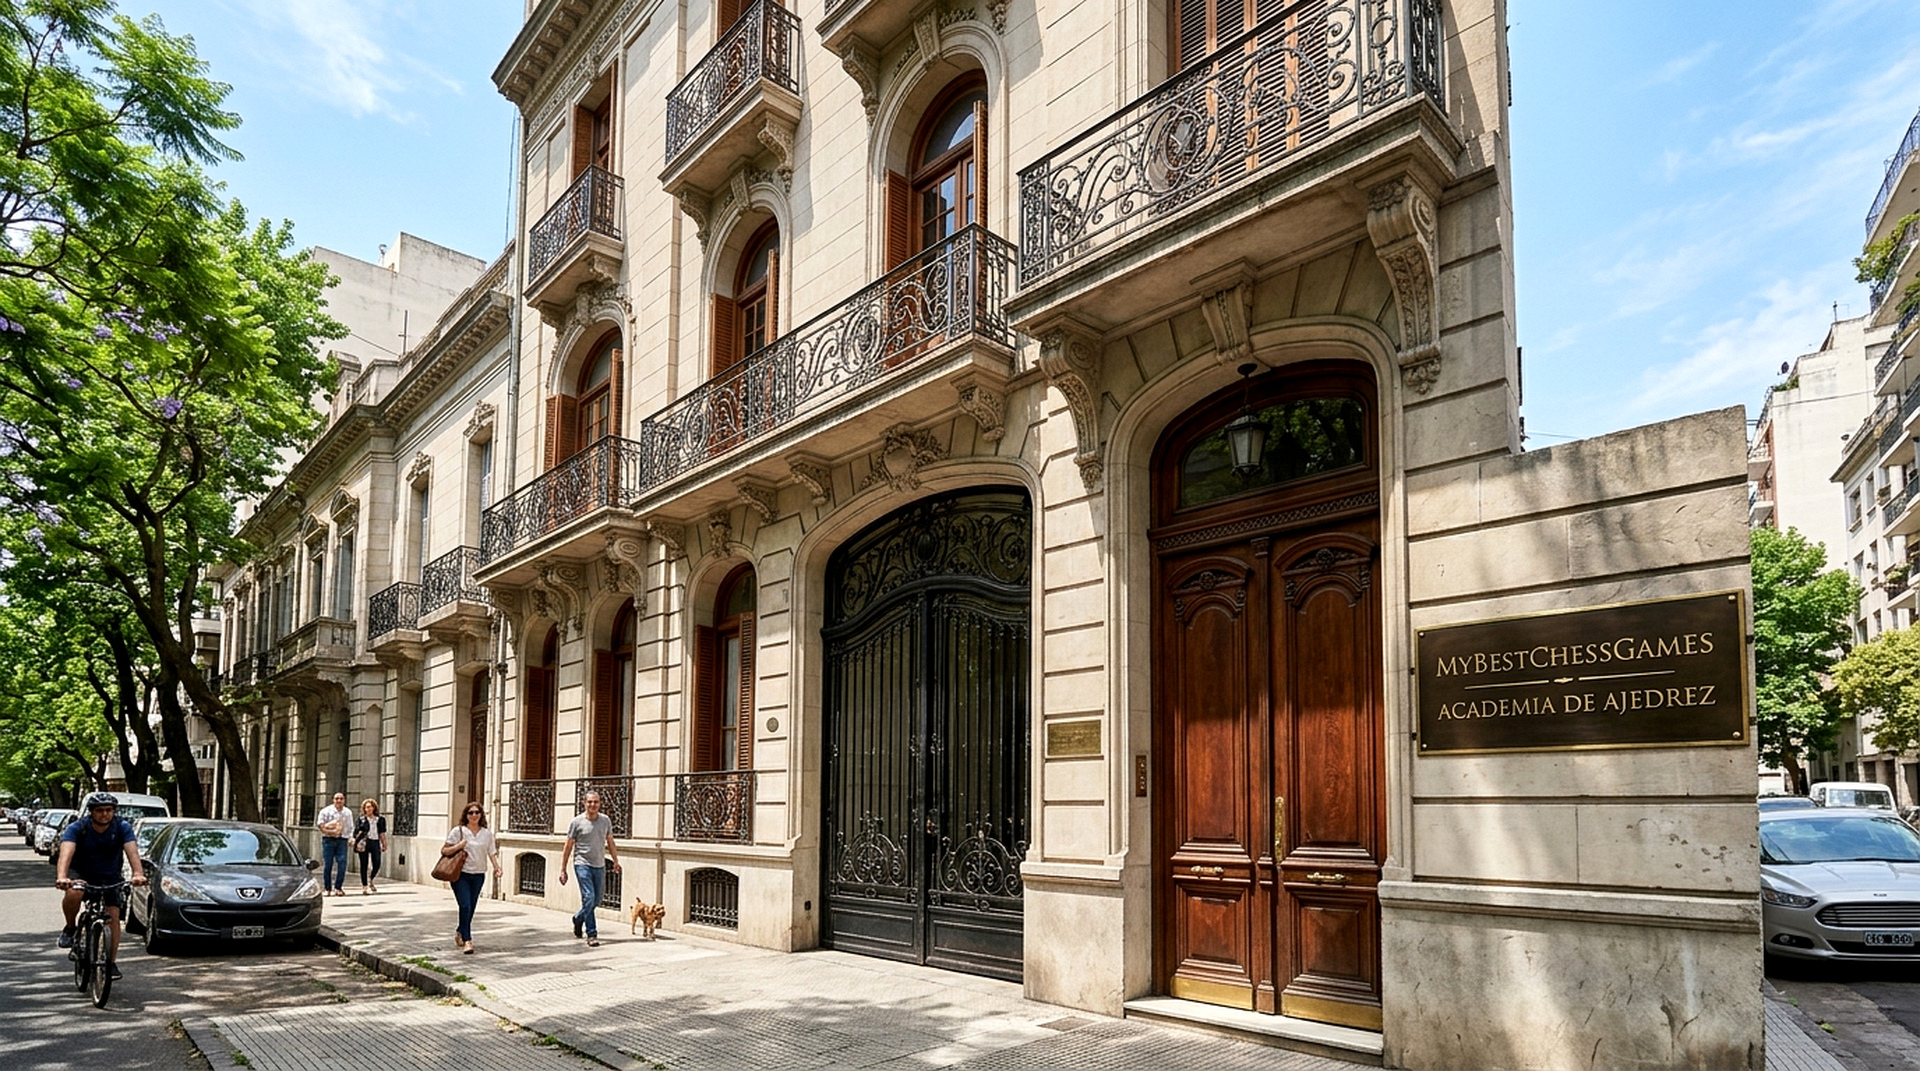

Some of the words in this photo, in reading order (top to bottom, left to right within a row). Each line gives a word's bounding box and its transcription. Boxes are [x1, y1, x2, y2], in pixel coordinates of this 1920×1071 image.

[1437, 697, 1556, 720] ACADEMIA
[1563, 693, 1596, 713] DE
[1603, 685, 1716, 715] AJEDREZ
